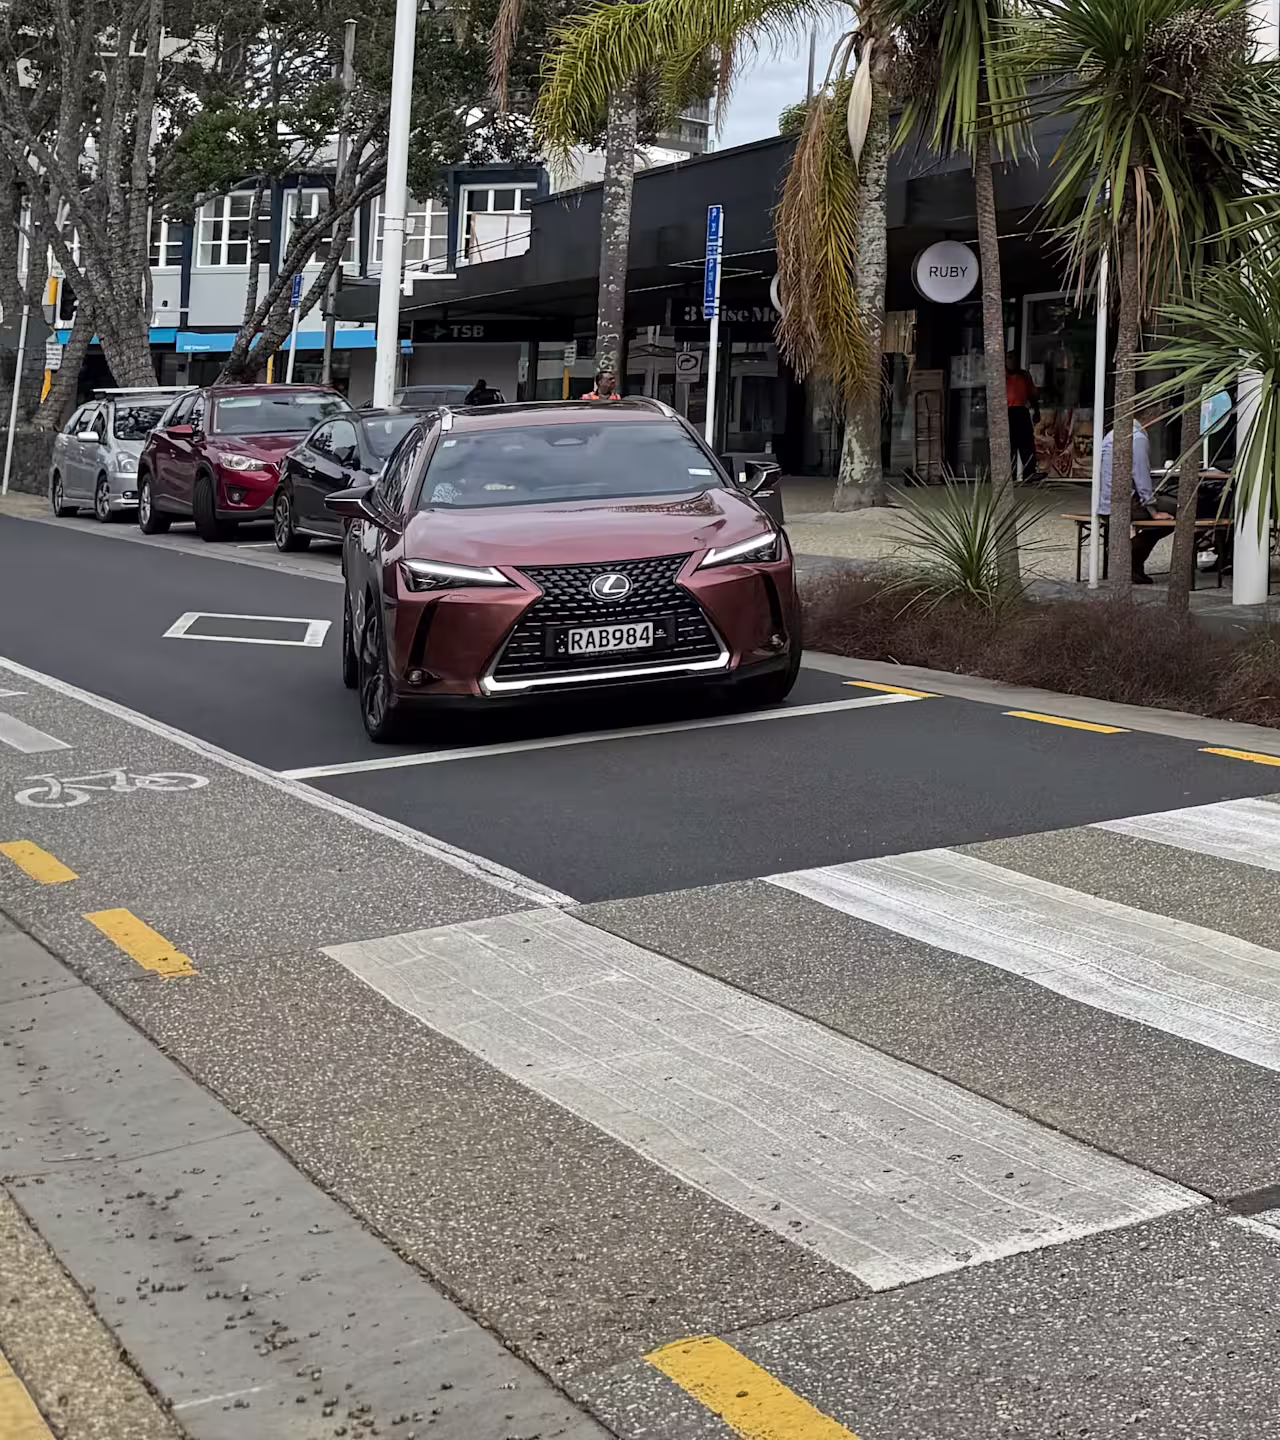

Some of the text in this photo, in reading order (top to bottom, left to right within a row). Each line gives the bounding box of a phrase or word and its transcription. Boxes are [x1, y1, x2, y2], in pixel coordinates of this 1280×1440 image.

[929, 266, 968, 278] RUBY
[683, 305, 697, 322] 3
[449, 325, 485, 338] TSB
[570, 625, 651, 651] RAB984
